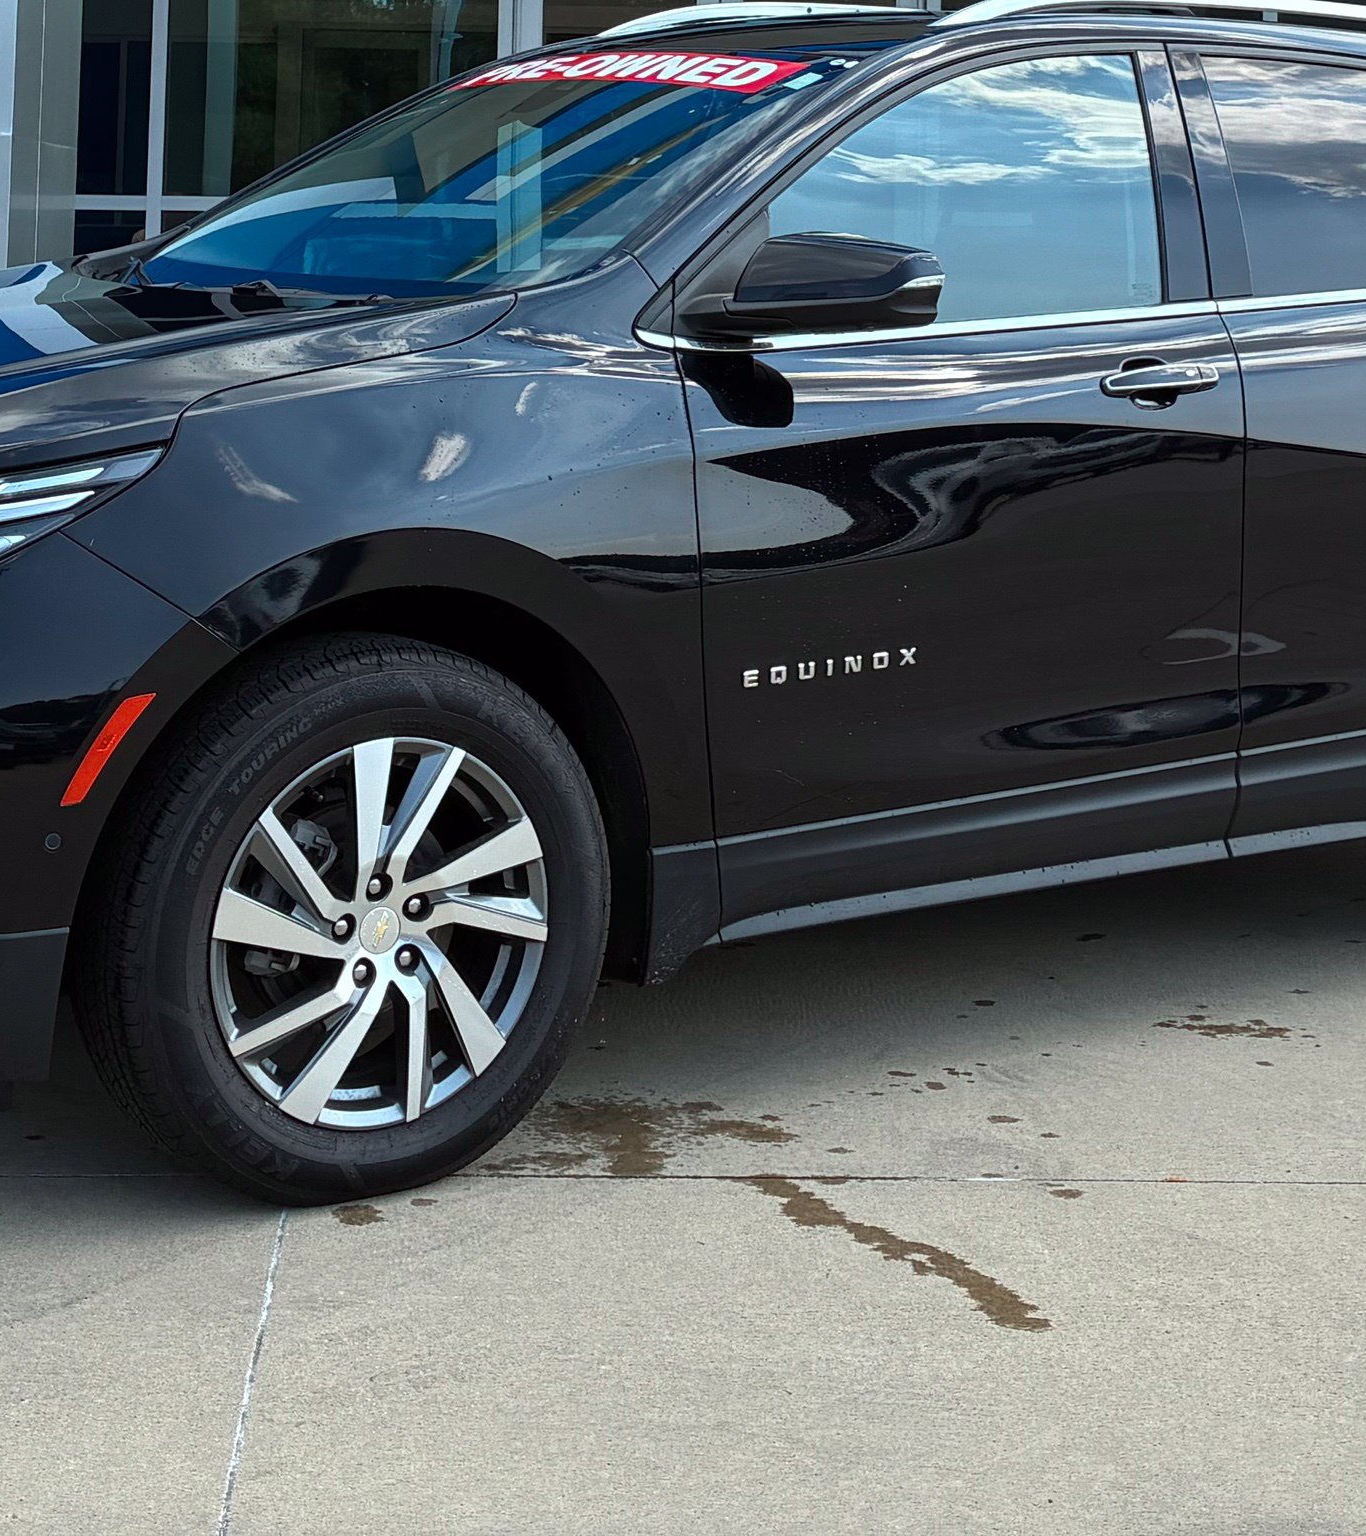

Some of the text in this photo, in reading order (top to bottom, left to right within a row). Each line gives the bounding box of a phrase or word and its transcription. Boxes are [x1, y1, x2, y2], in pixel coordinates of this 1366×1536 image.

[464, 53, 779, 88] PRE-OWNED
[742, 647, 917, 689] EQUINOX
[185, 715, 314, 876] EDGE TOURING
